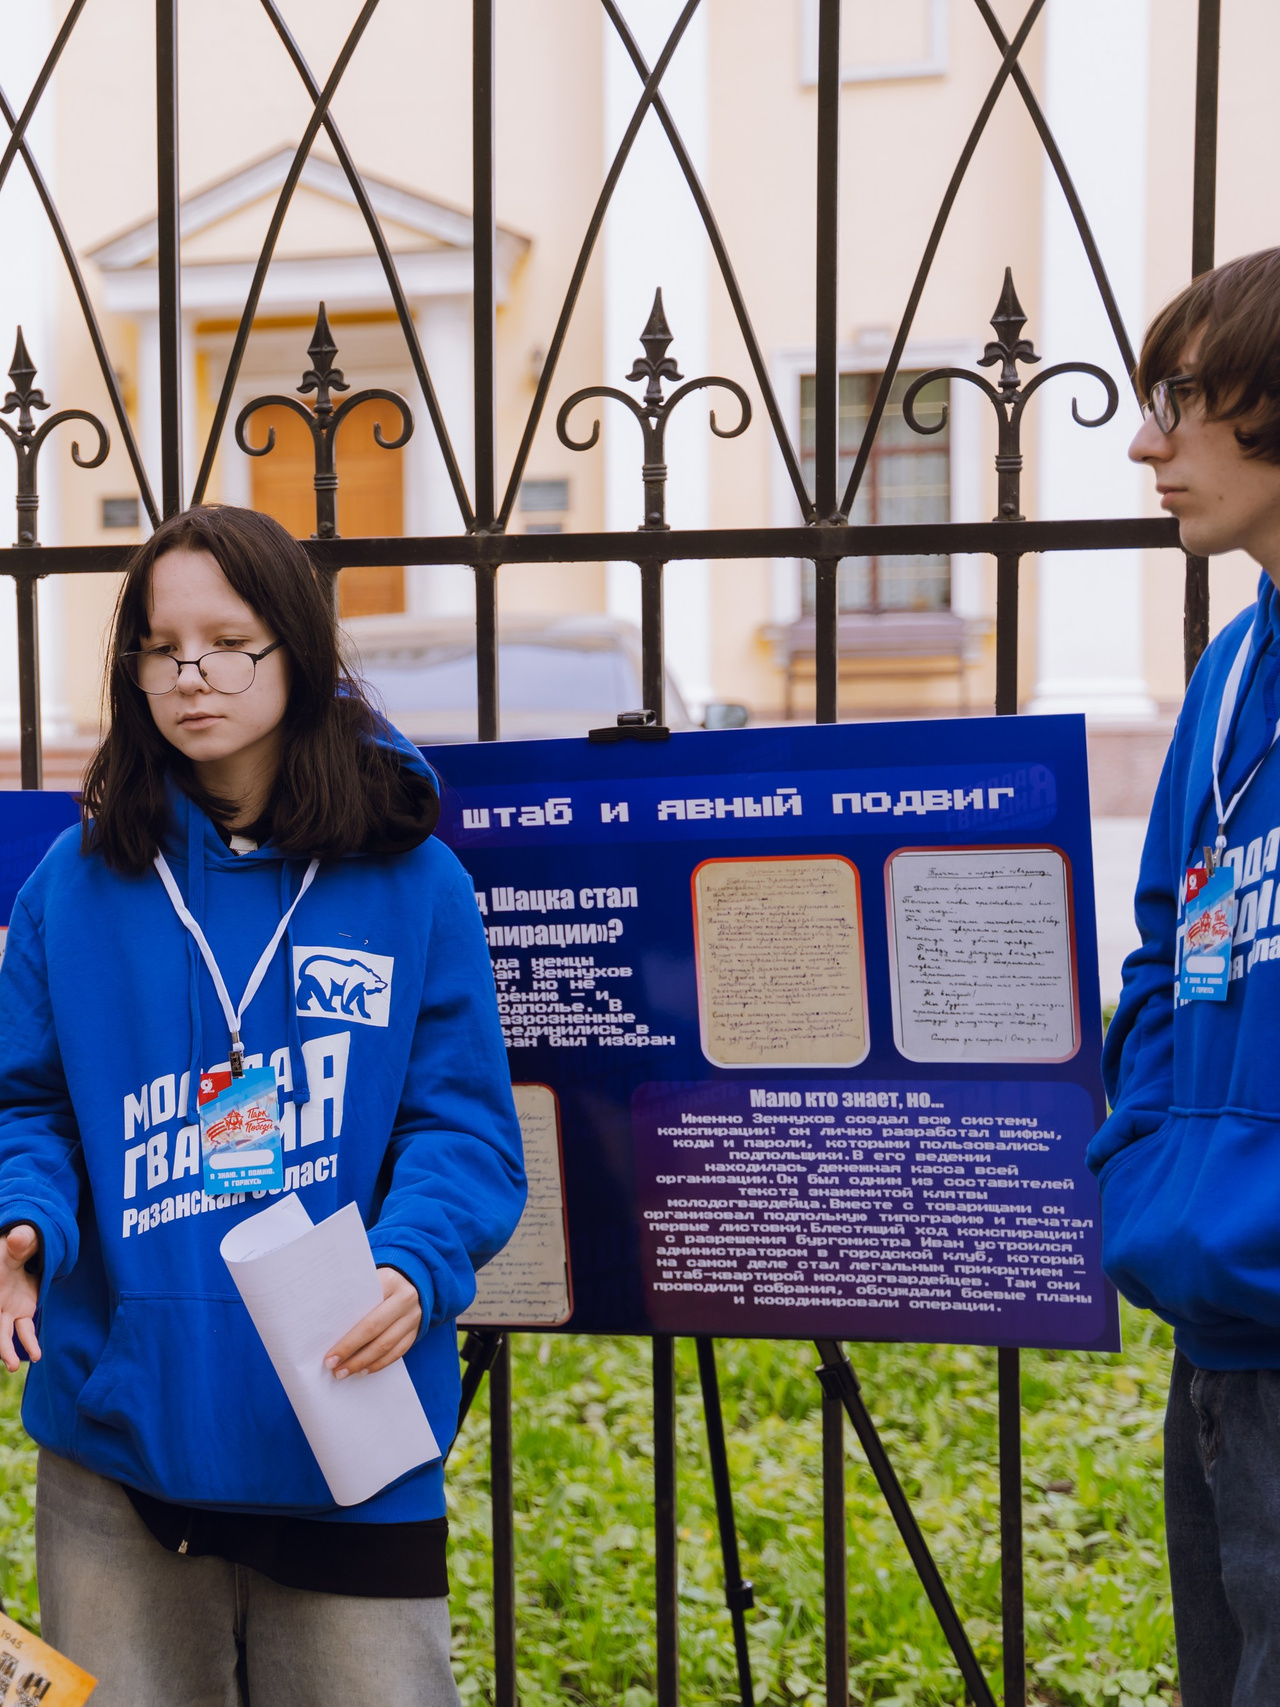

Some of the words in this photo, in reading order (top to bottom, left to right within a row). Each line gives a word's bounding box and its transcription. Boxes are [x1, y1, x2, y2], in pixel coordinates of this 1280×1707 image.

[463, 797, 572, 829] штаб
[600, 802, 629, 823] и
[657, 787, 802, 823] явный
[832, 786, 1014, 815] подвиг
[492, 887, 575, 913] Шацка
[579, 887, 638, 908] стал
[531, 957, 594, 968] немцы
[494, 970, 520, 979] ан
[532, 967, 632, 979] Земнухов
[533, 981, 558, 990] но
[571, 980, 595, 989] не
[596, 991, 609, 1000] и
[609, 999, 622, 1012] В
[636, 1025, 648, 1034] в
[549, 1035, 587, 1046] был
[599, 1033, 675, 1047] избран
[750, 1089, 801, 1107] Мало
[805, 1092, 838, 1107] кто
[842, 1092, 903, 1109] знает,
[247, 1107, 270, 1118] Парк
[682, 1114, 743, 1123] Именно
[753, 1114, 835, 1124] Земнухов
[845, 1115, 908, 1125] создал
[919, 1116, 951, 1124] всю
[961, 1116, 1037, 1127] систему
[657, 1127, 776, 1136] конспирации:
[820, 1128, 872, 1136] лично
[883, 1127, 989, 1138] разработал
[1000, 1130, 1062, 1140] шифры,
[674, 1139, 714, 1148] коды
[724, 1139, 734, 1147] и
[744, 1139, 812, 1149] пароли,
[826, 1140, 910, 1149] которыми
[920, 1141, 1049, 1151] пользовались
[874, 1153, 905, 1161] его
[916, 1153, 991, 1162] ведении
[705, 1163, 807, 1172] находилась
[817, 1164, 901, 1174] денежная
[911, 1165, 965, 1174] касса
[975, 1165, 1019, 1175] всей
[808, 1174, 839, 1185] был
[849, 1175, 902, 1186] одним
[912, 1177, 933, 1186] из
[944, 1178, 1074, 1190] составителей
[739, 1188, 799, 1196] текста
[809, 1188, 913, 1198] знаменитой
[923, 1190, 988, 1199] клятвы
[903, 1202, 914, 1210] с
[926, 1202, 1031, 1213] товарищами
[1043, 1205, 1065, 1214] он
[644, 1211, 754, 1220] организовал
[764, 1211, 867, 1222] подпольную
[879, 1213, 983, 1225] типографию
[994, 1216, 1005, 1225] и
[1016, 1217, 1093, 1228] печатал
[650, 1223, 709, 1232] первые
[915, 1227, 948, 1236] ход
[958, 1228, 1084, 1240] конспирации:
[665, 1235, 675, 1243] с
[685, 1235, 786, 1245] разрешения
[796, 1235, 911, 1247] бургомистра
[921, 1237, 964, 1248] Иван
[974, 1240, 1072, 1252] устроился
[657, 1246, 808, 1257] администратором
[818, 1249, 828, 1257] в
[840, 1249, 932, 1259] городской
[943, 1251, 993, 1263] клуб,
[1007, 1253, 1084, 1265] который
[657, 1259, 677, 1267] на
[687, 1259, 737, 1268] самом
[748, 1259, 787, 1269] деле
[798, 1260, 839, 1269] стал
[850, 1261, 944, 1272] легальным
[955, 1264, 1063, 1276] прикрытием
[662, 1269, 804, 1281] штаб-квартирой
[814, 1272, 990, 1286] молодогвардейцев.
[1005, 1276, 1036, 1289] Там
[1047, 1280, 1080, 1290] они
[654, 1281, 744, 1292] проводили
[753, 1282, 842, 1295] собрания,
[856, 1285, 951, 1298] обсуждали
[961, 1289, 1026, 1300] боевые
[1036, 1292, 1092, 1303] планы
[734, 1296, 745, 1304] и
[754, 1296, 899, 1308] координировали
[910, 1301, 1001, 1311] операции.
[0, 1630, 24, 1650] 1945
